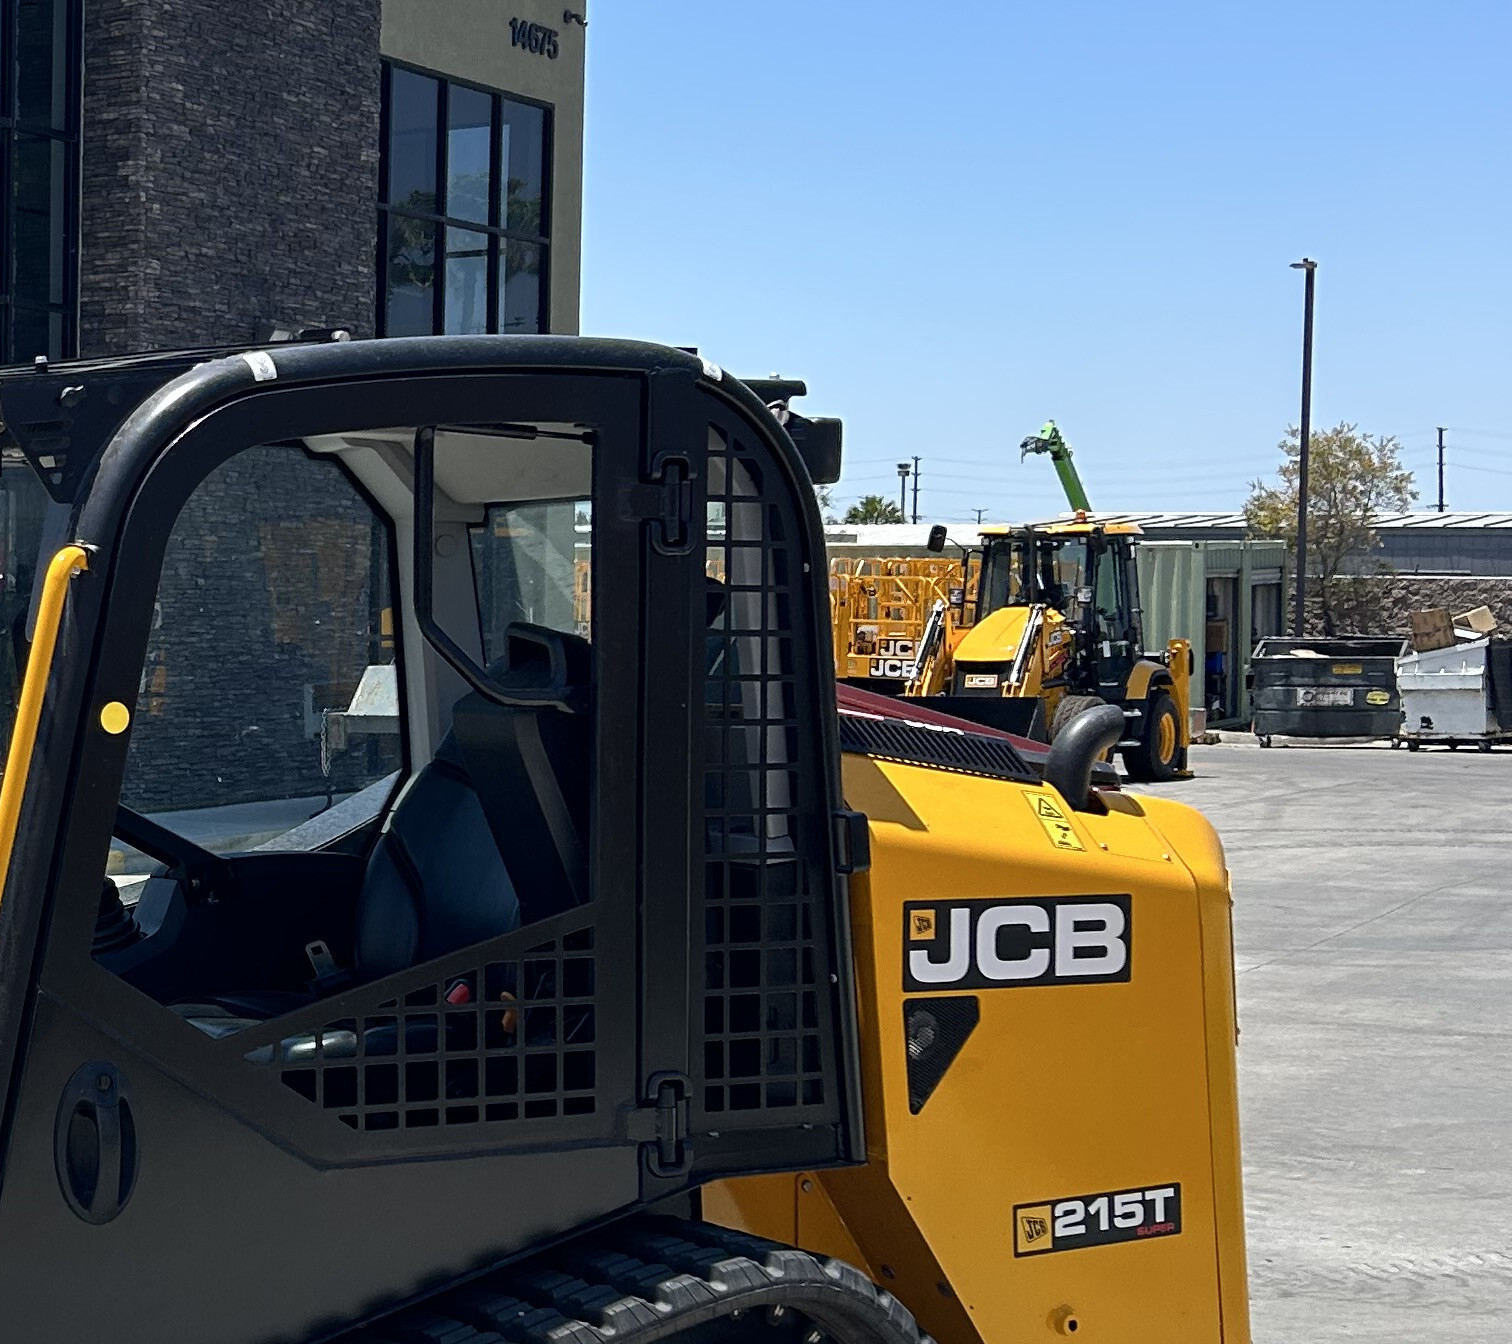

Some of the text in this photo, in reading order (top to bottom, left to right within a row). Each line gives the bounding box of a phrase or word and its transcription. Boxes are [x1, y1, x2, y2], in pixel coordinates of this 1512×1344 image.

[509, 17, 559, 59] 14675
[879, 640, 921, 656] JC
[968, 676, 996, 686] JCB
[909, 902, 1128, 983] JCB
[1054, 1187, 1175, 1238] 215T
[1136, 1222, 1176, 1236] SUPER
